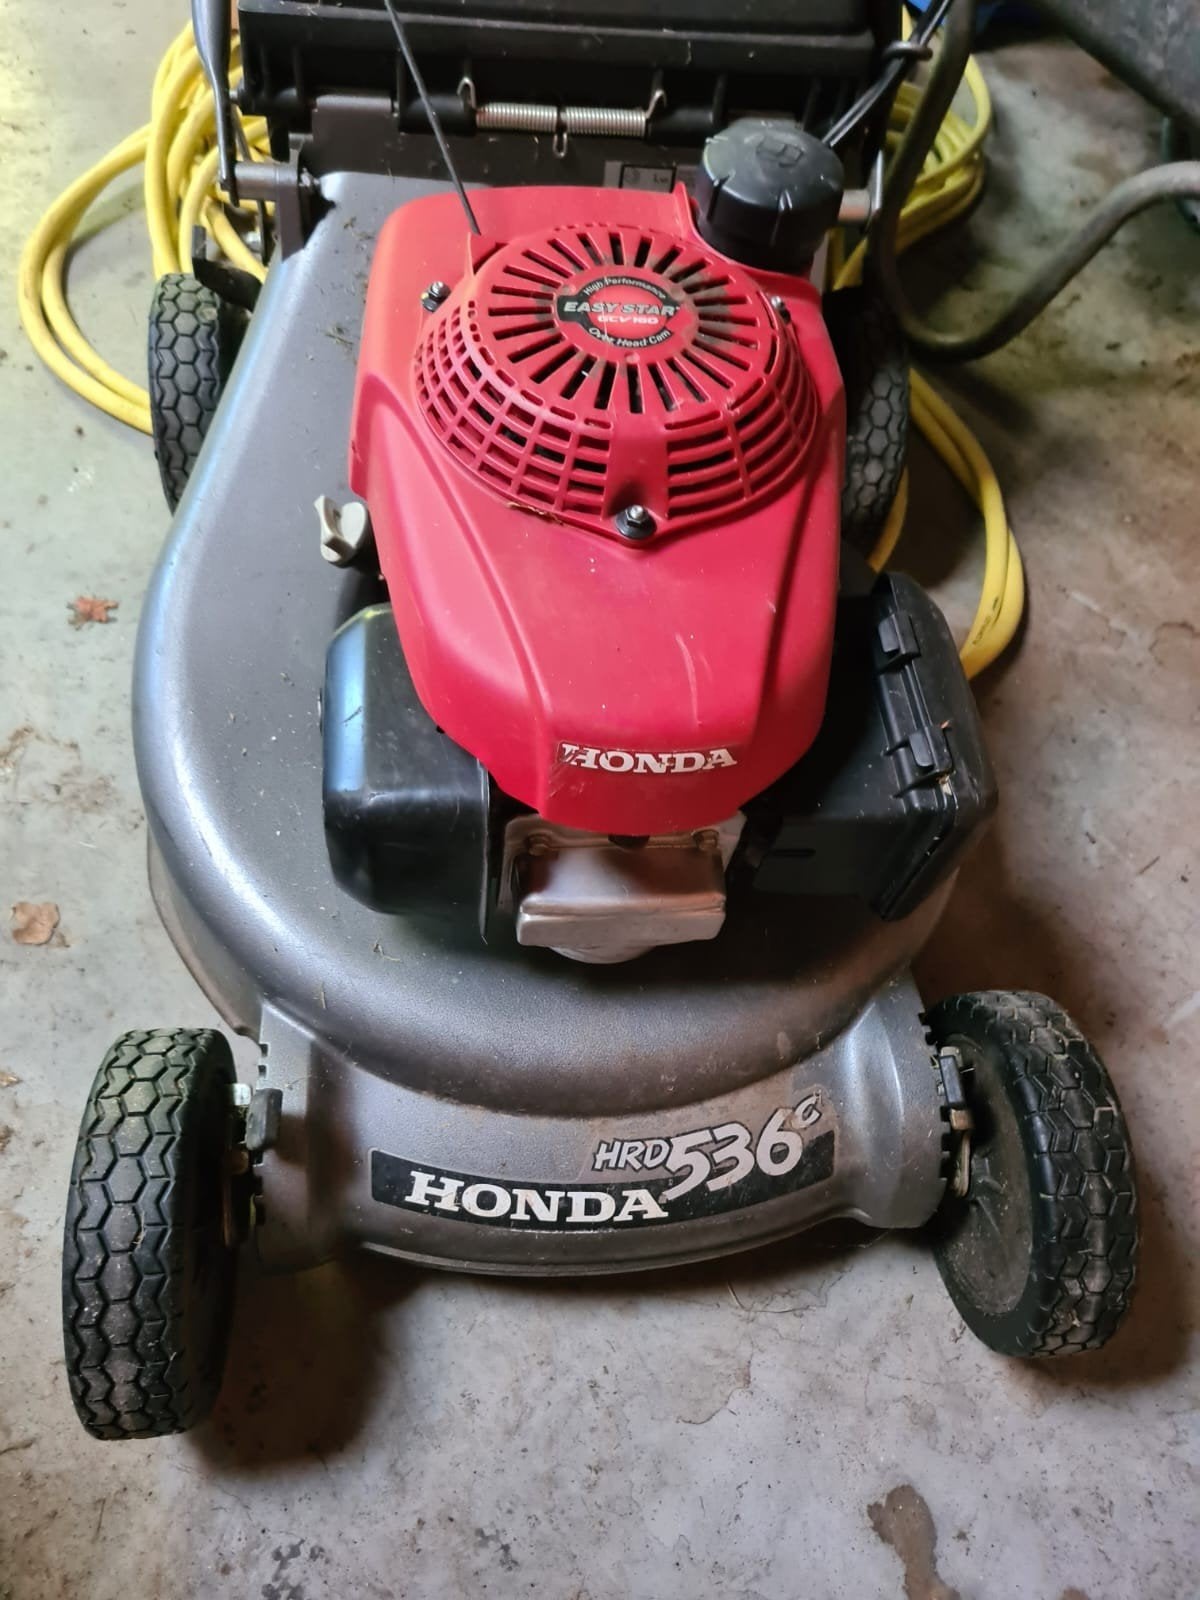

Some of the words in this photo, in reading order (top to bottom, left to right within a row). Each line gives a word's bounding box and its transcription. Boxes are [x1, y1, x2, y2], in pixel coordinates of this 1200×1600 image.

[583, 280, 605, 296] High
[604, 277, 666, 300] Performance
[564, 301, 618, 314] EASY
[622, 303, 675, 317] STAR
[588, 327, 614, 343] Over
[617, 338, 647, 348] Head
[649, 329, 671, 345] Cam
[562, 743, 737, 773] HONDA
[405, 1170, 668, 1222] HONDA
